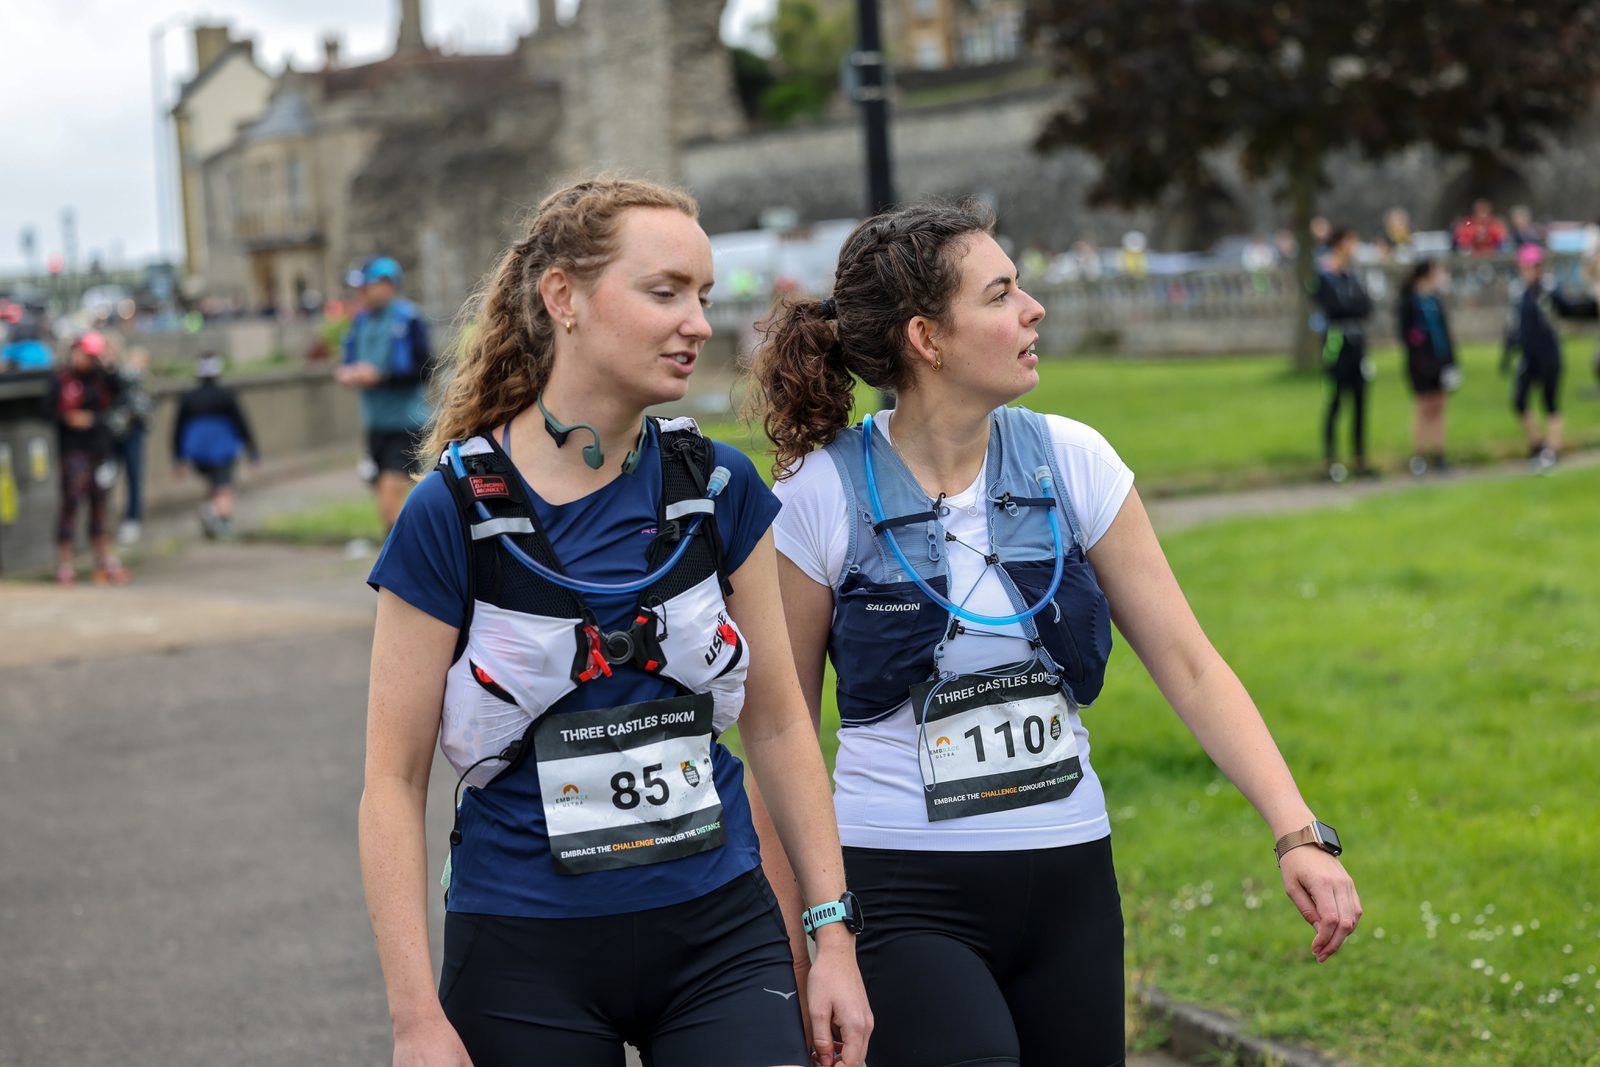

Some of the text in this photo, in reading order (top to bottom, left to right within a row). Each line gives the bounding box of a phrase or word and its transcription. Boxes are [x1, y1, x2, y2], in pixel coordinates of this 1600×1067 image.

[865, 602, 920, 612] SALOMON
[936, 686, 975, 705] THREE
[977, 675, 1028, 694] CASTLES
[560, 710, 695, 742] THREE CASTLES 50KM
[964, 715, 1045, 763] 110
[610, 763, 670, 811] 85
[934, 772, 1079, 806] EMBRACE THE CHALLENGE CONQUER THE DISTANCE
[561, 821, 721, 859] EMBRACE THE CHALLENGE CONQUER THE DISTANCE
